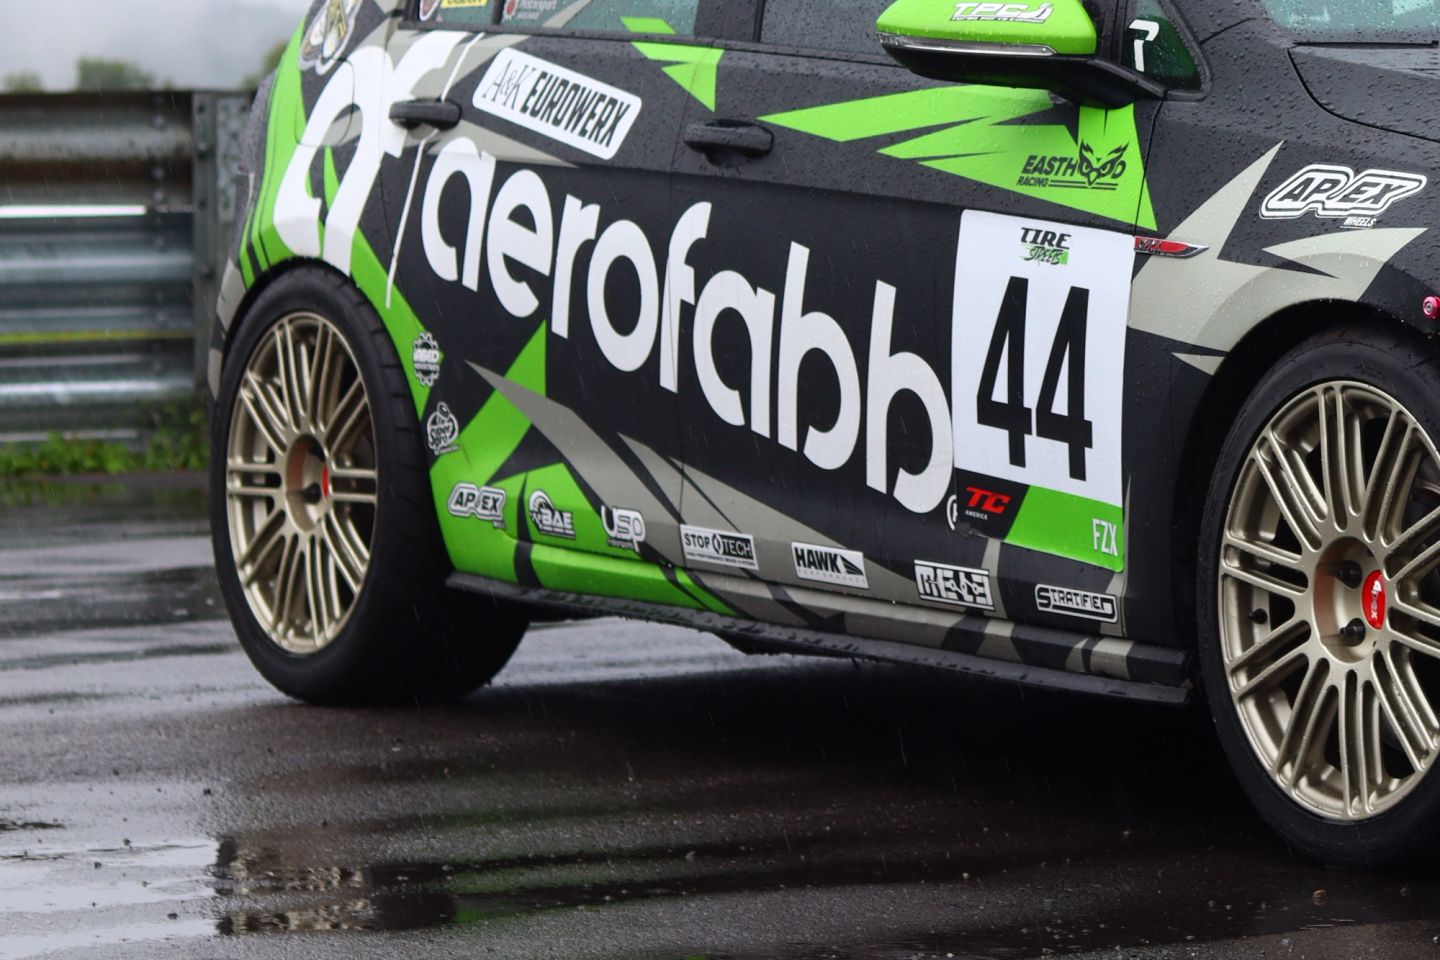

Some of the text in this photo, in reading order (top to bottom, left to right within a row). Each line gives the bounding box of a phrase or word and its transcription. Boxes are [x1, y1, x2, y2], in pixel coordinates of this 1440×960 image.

[482, 60, 630, 147] A&K EUROWERX
[1016, 175, 1050, 188] RACING
[1020, 227, 1071, 250] TIRE
[1344, 216, 1377, 228] WHEELS
[422, 136, 955, 514] aerofabb
[976, 275, 1093, 482] 44
[965, 486, 1011, 514] TC
[602, 505, 647, 553] USP
[1092, 518, 1118, 557] FZX
[795, 547, 841, 574] HAWK
[1036, 587, 1116, 620] STRATIFIED
